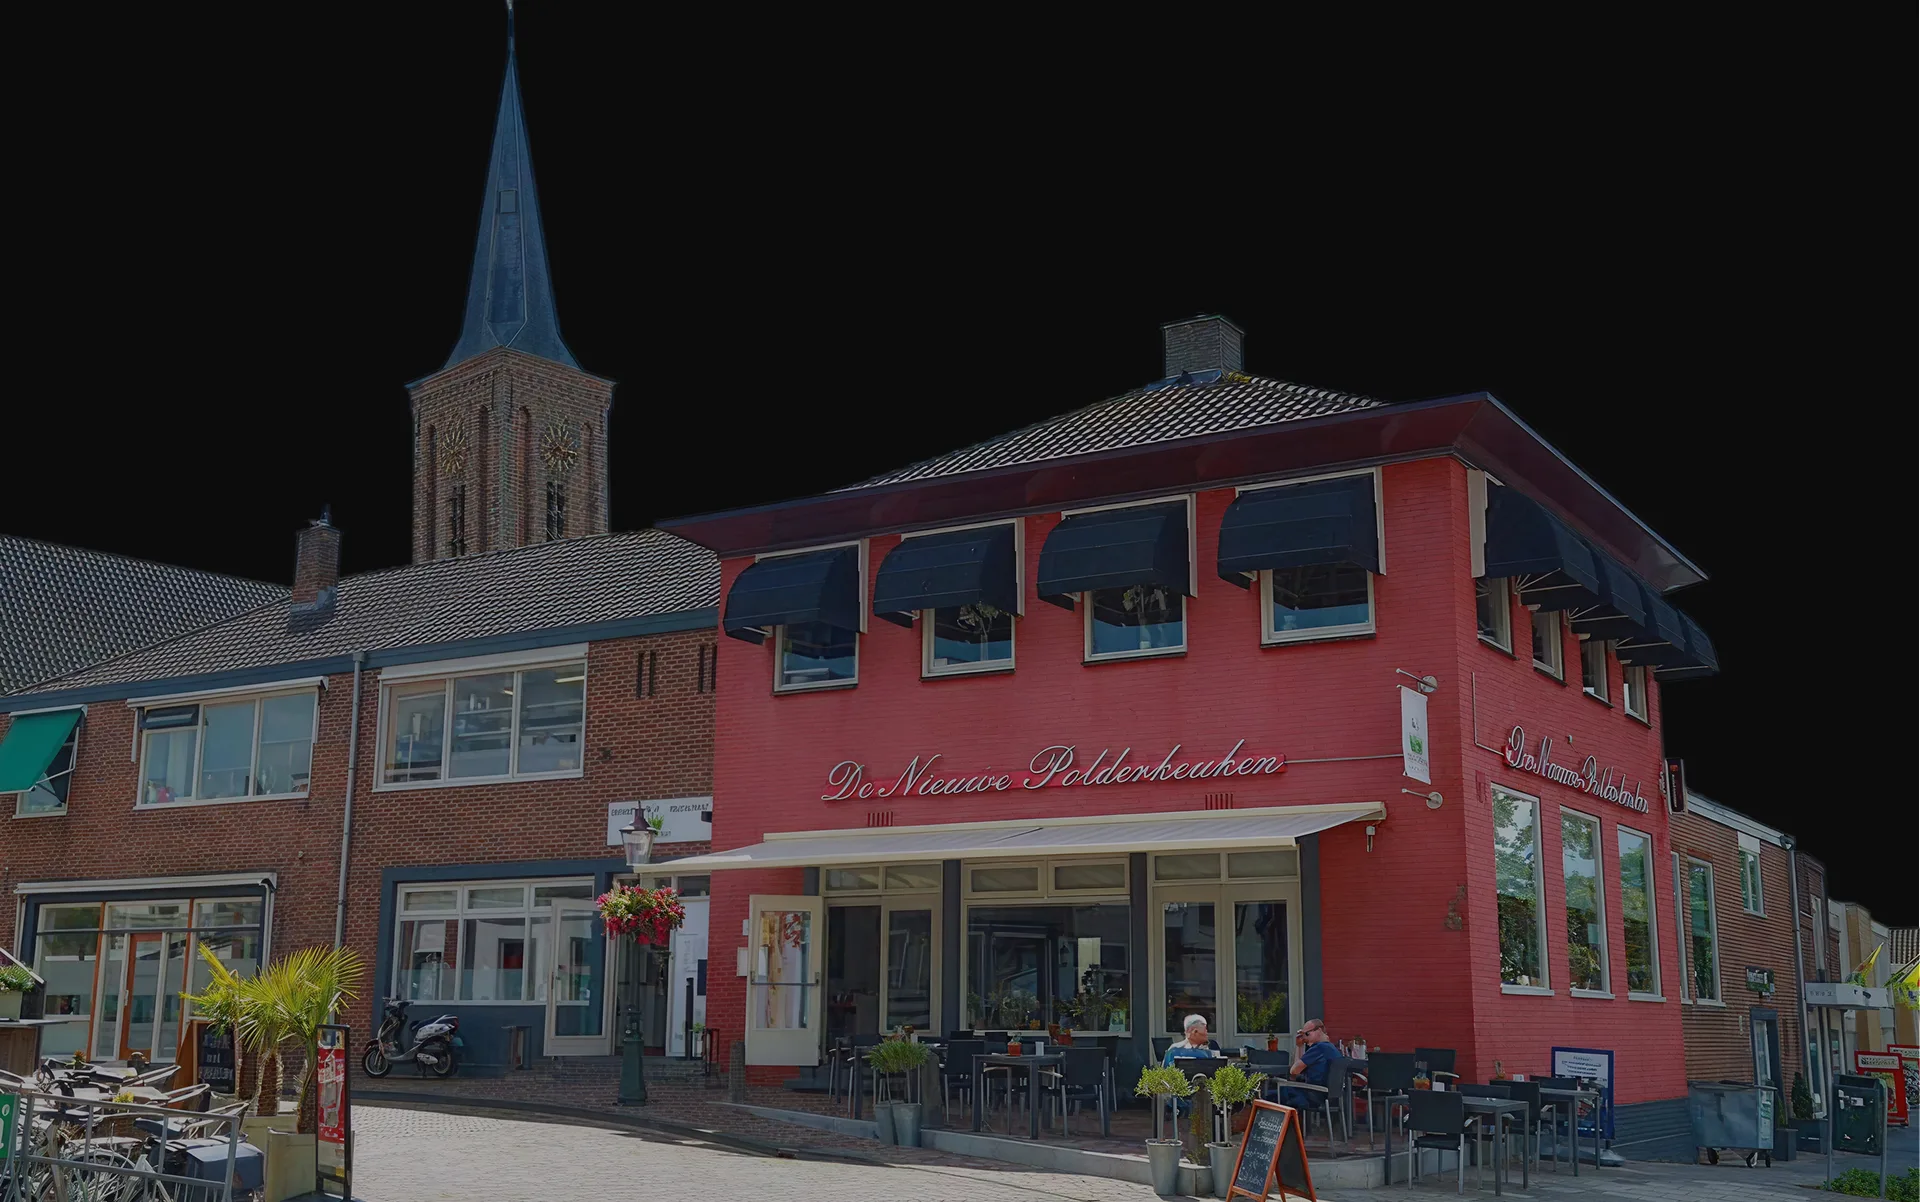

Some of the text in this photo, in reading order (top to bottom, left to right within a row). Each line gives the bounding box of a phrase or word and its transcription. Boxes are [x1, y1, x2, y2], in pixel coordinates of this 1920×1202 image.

[821, 739, 1285, 801] De Nieuwe Polderkeuken
